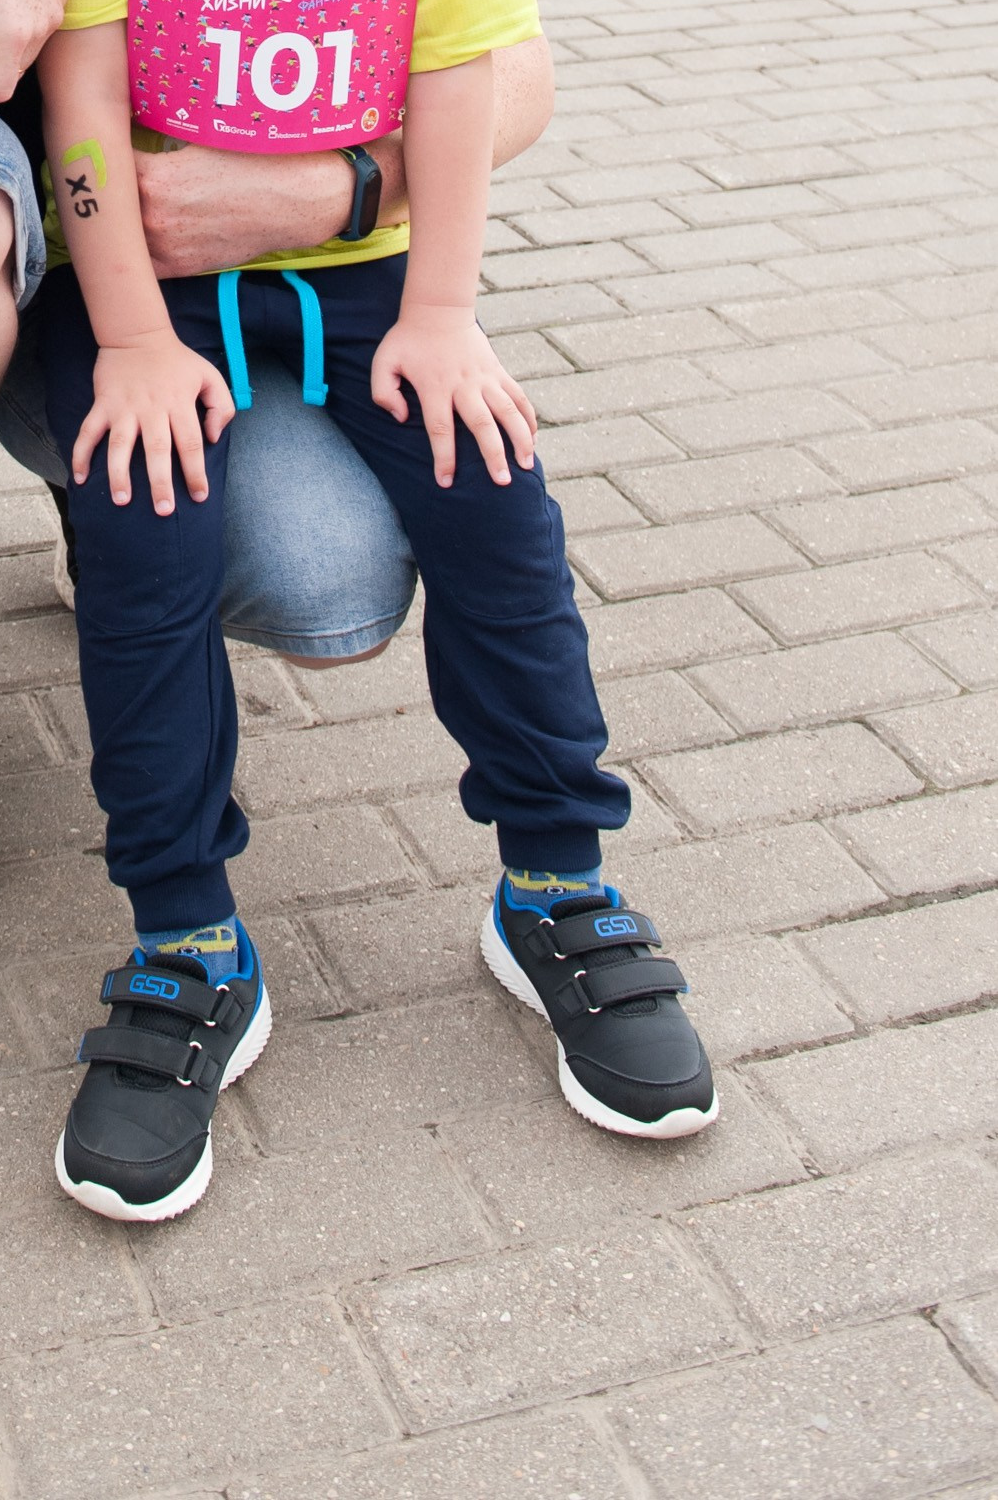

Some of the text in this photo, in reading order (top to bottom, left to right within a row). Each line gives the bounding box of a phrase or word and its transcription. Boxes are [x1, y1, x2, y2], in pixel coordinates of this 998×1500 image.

[205, 26, 354, 110] 101
[64, 173, 99, 219] X5
[594, 915, 639, 938] GSD
[129, 973, 180, 1000] GSD
